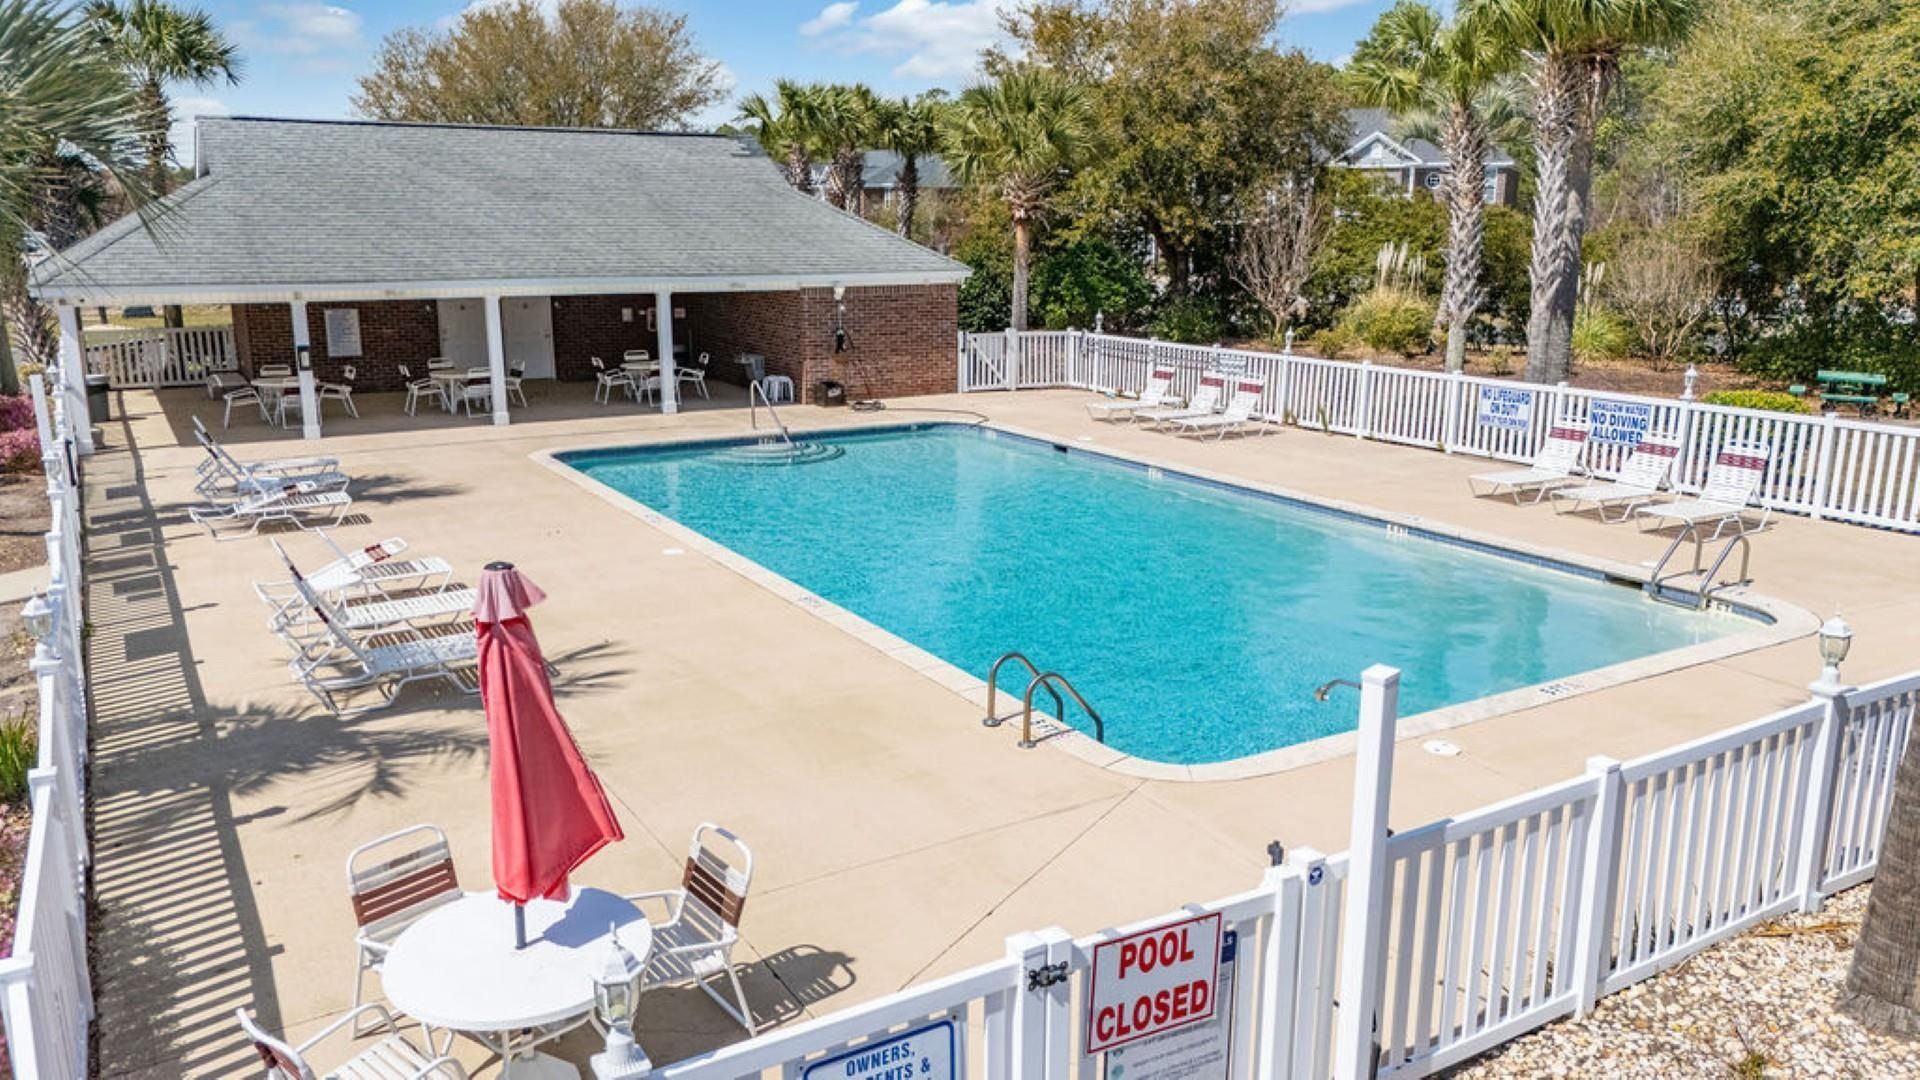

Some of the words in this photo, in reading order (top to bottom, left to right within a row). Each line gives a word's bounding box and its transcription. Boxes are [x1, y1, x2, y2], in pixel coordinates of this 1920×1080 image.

[1481, 387, 1493, 400] NO
[1493, 388, 1531, 406] LIFEGUARD
[1490, 402, 1500, 414] ON
[1501, 403, 1519, 416] DUTY
[1593, 401, 1623, 413] SHALLOW
[1624, 405, 1649, 416] WATER
[1591, 411, 1606, 425] NO
[1609, 413, 1648, 430] DIVING
[1591, 426, 1643, 443] ALLOWED
[1118, 928, 1194, 980] POOL
[1096, 979, 1209, 1042] CLOSED
[921, 1056, 931, 1073] &
